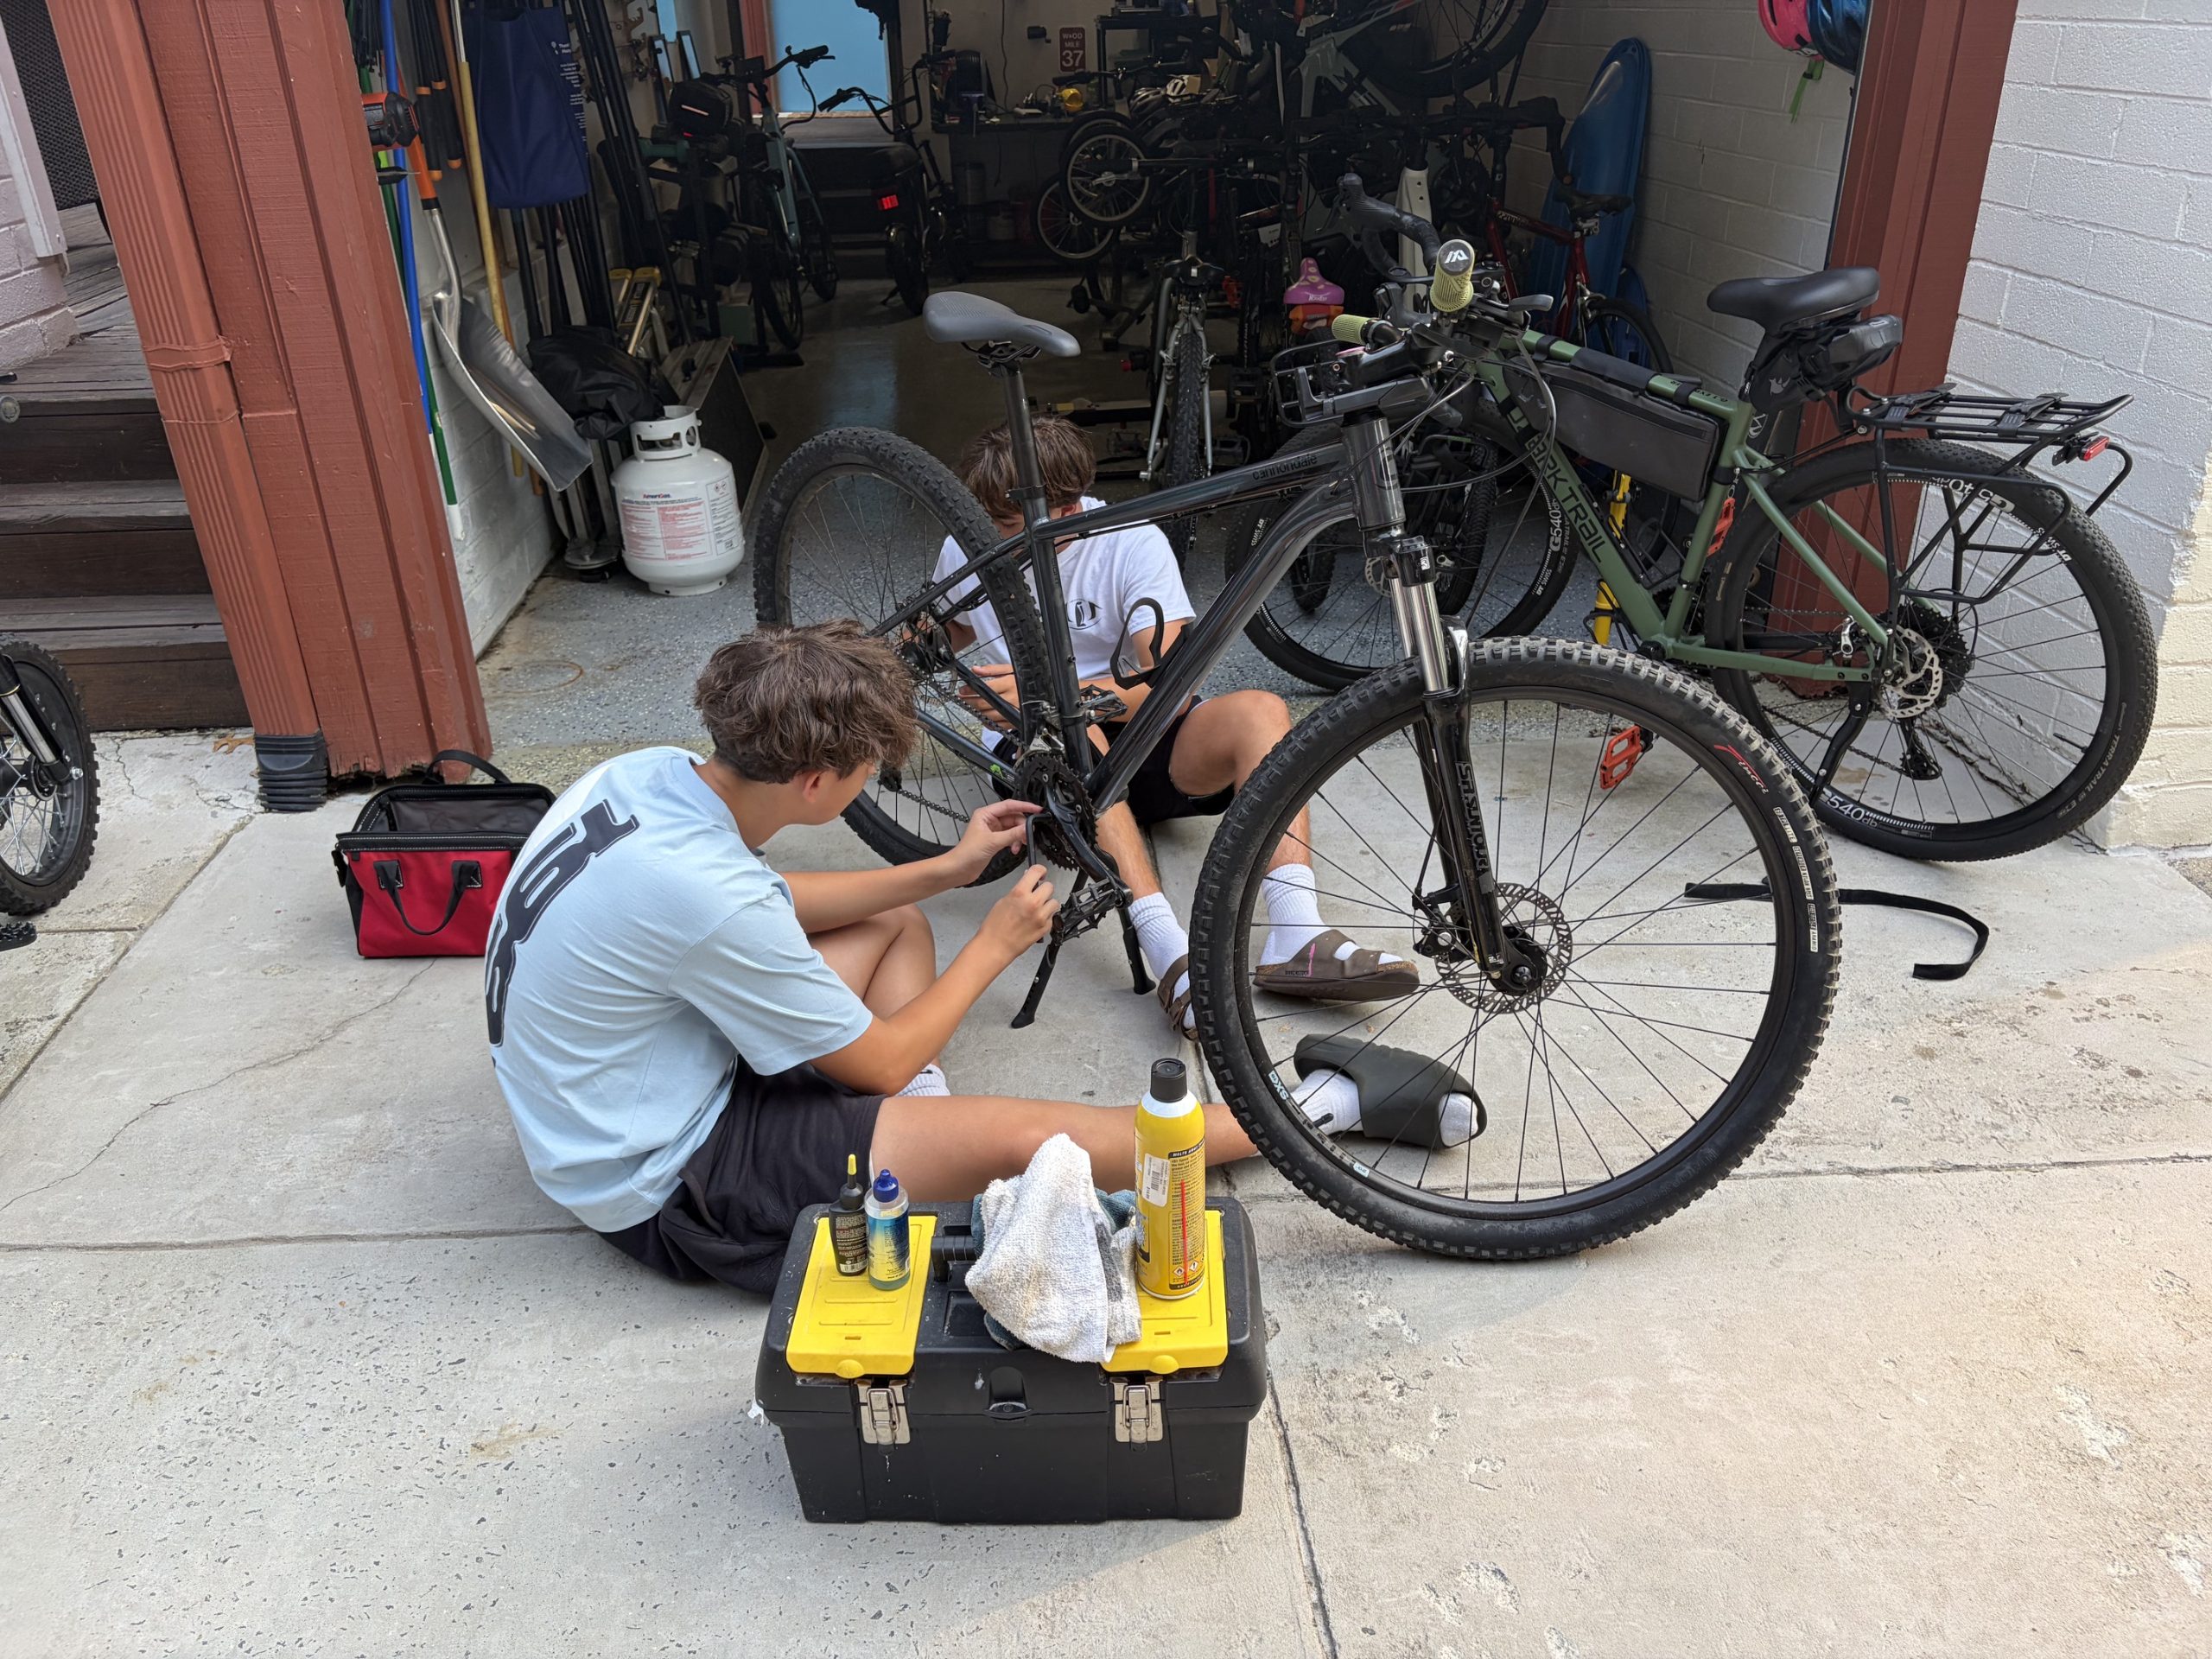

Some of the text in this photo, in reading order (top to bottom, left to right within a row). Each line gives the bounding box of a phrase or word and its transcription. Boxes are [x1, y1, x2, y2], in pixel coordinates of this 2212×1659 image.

[1062, 50, 1084, 67] 37
[1252, 454, 1318, 480] cannondale
[2036, 527, 2072, 563] DT SWS
[1536, 569, 1553, 596] DT SWISS
[2085, 734, 2120, 792] TERRA TRAIL
[1274, 1080, 1289, 1101] SX
